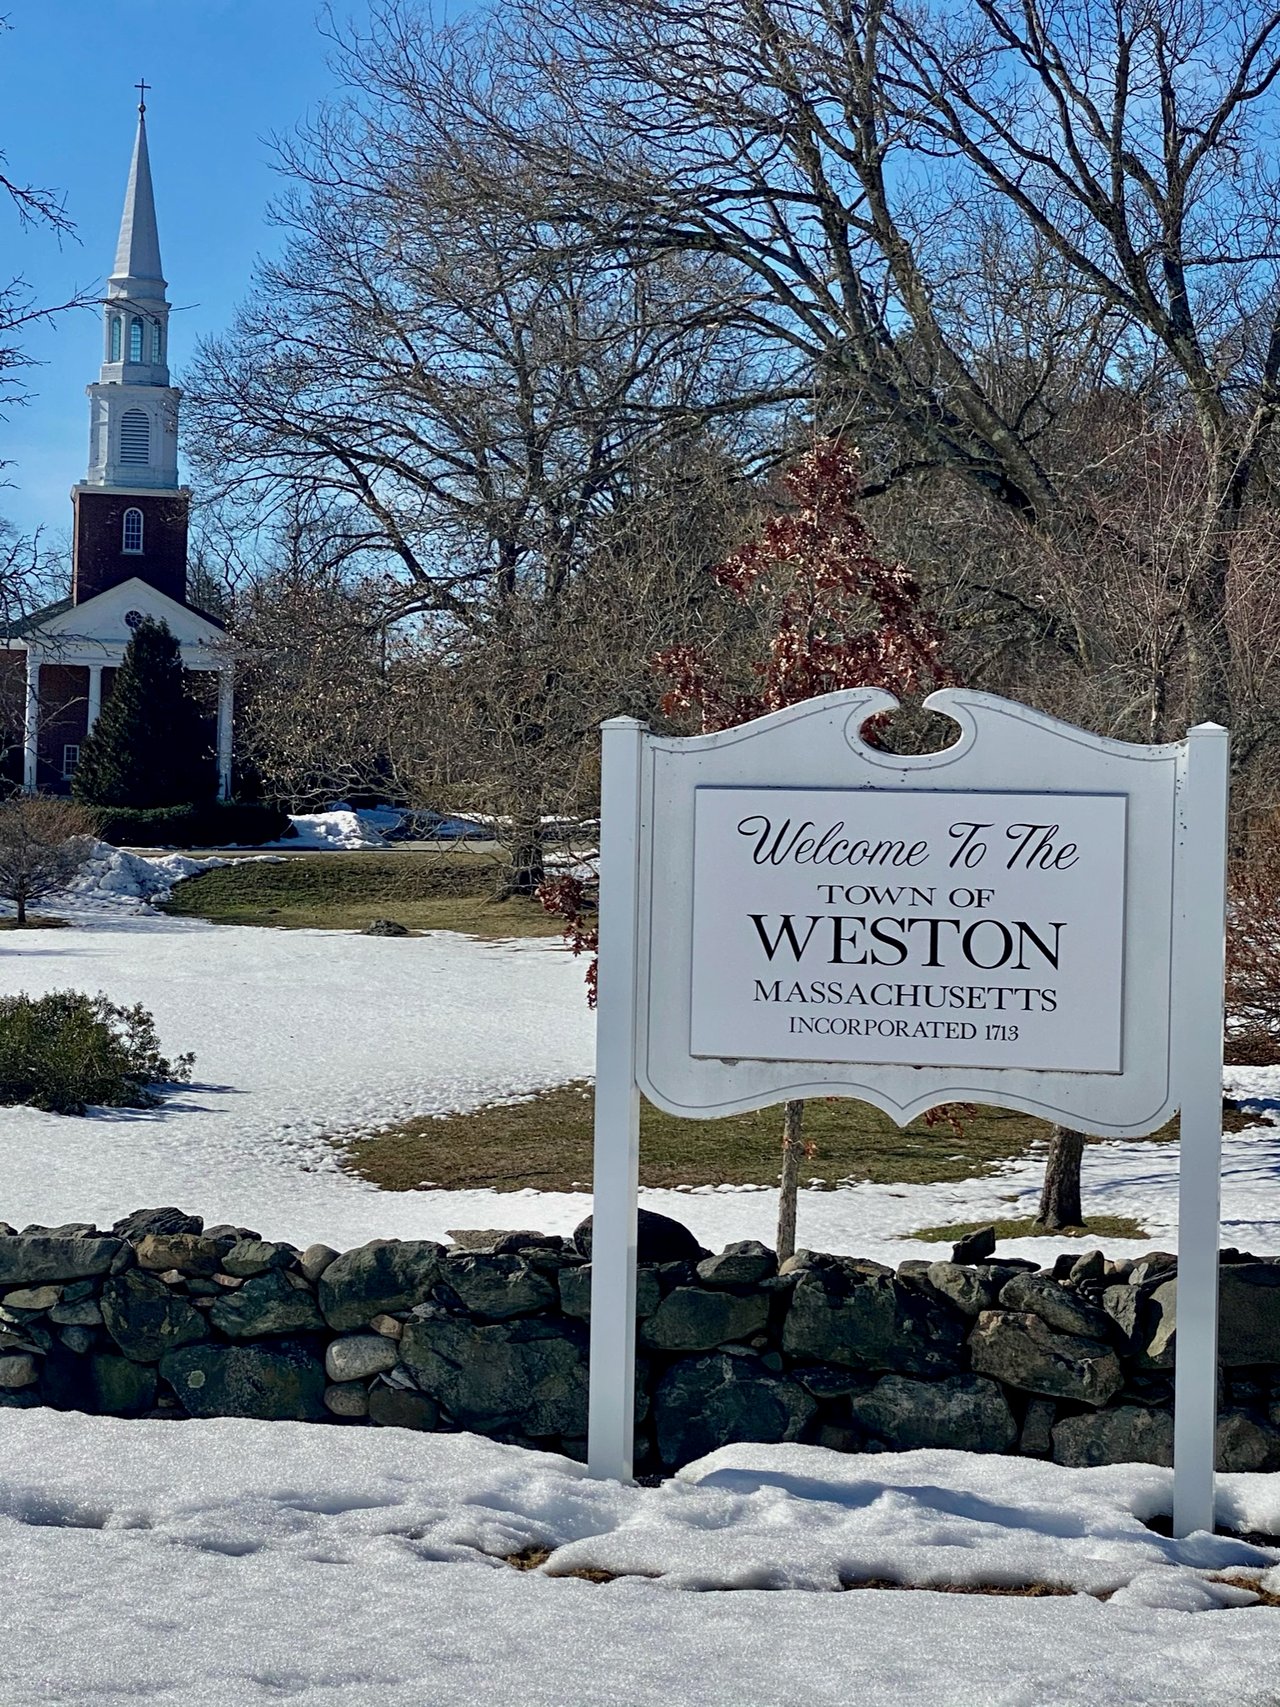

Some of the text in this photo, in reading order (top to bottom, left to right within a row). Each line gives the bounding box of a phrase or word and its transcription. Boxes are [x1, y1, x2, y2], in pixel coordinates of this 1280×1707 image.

[737, 815, 1080, 871] Welcome To The
[816, 884, 995, 909] TOWN OF
[746, 913, 1068, 971] WESTON
[753, 979, 1058, 1012] MASSACHUSETTS
[789, 1016, 1019, 1042] INCORPORATED 1713
